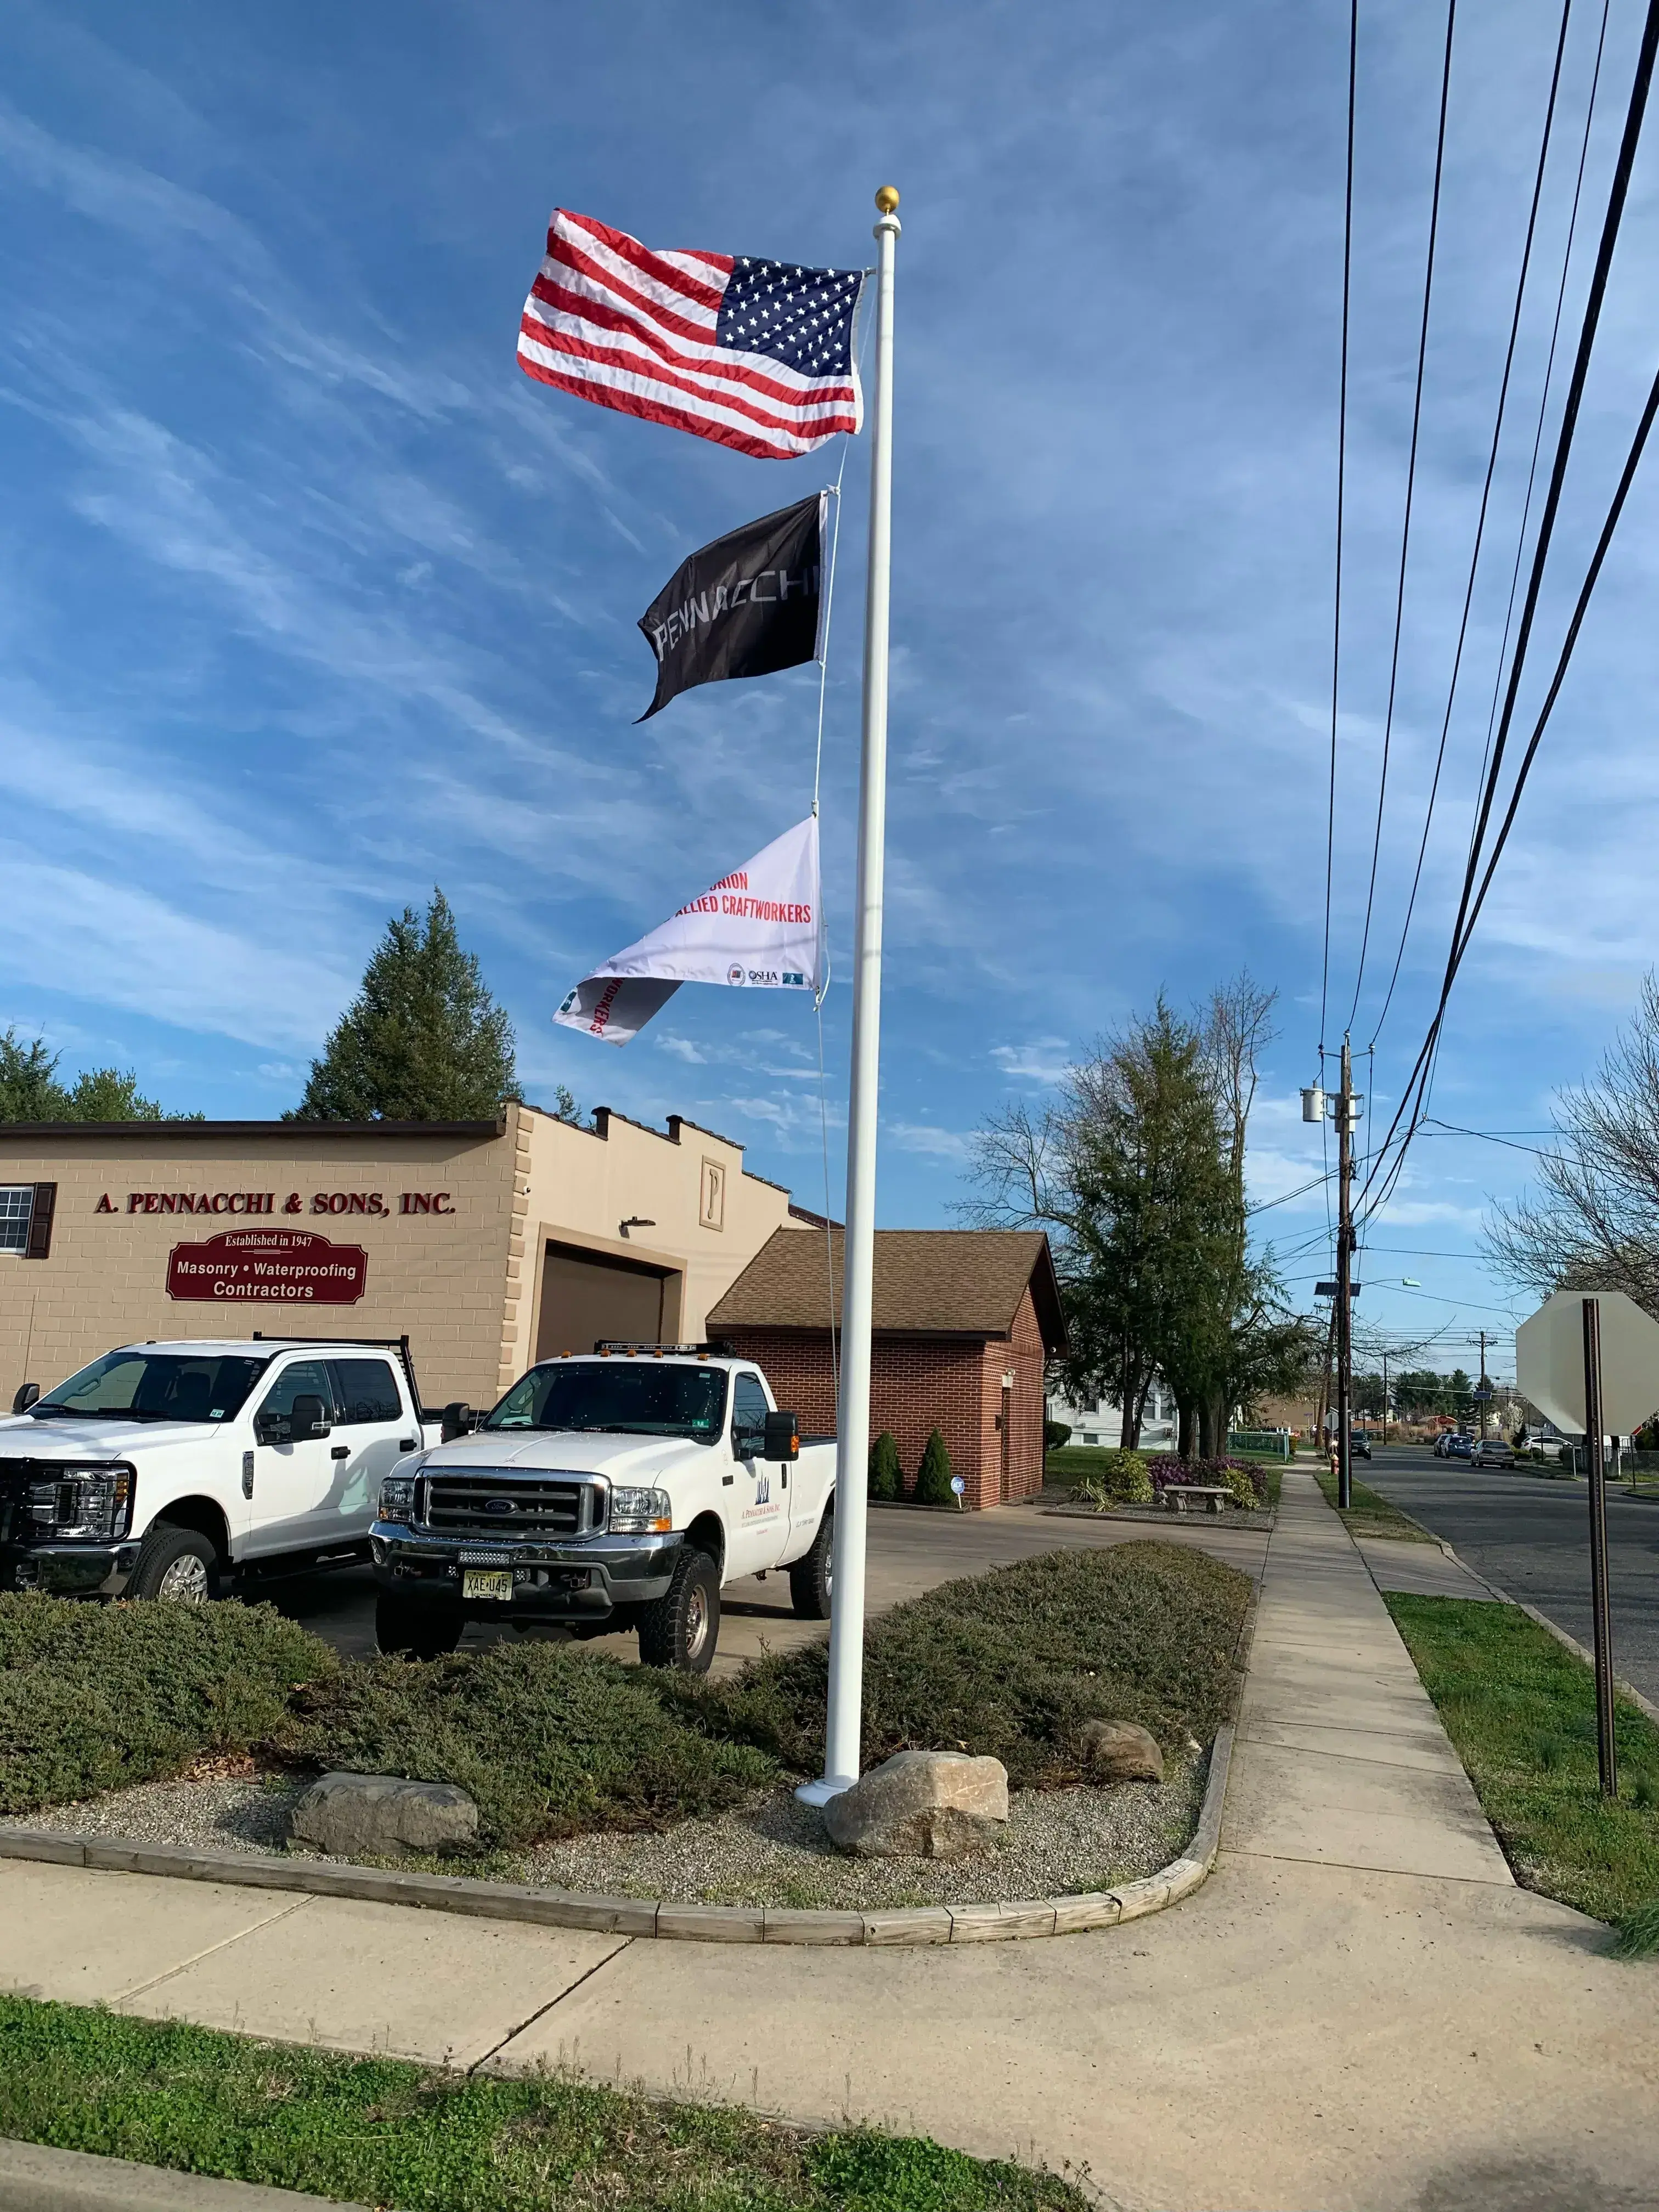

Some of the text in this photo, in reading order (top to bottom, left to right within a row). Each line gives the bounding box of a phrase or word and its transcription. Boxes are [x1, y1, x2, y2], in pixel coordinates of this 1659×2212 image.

[722, 895, 811, 923] CRAFTWORKERS
[748, 970, 778, 980] OSHA
[97, 1192, 456, 1220] A. PENNACCHI & SONS, INC.
[225, 1234, 312, 1247] Established in 1947
[177, 1261, 239, 1278] Masonry
[253, 1263, 357, 1280] Waterproofing
[213, 1281, 314, 1297] Contractors
